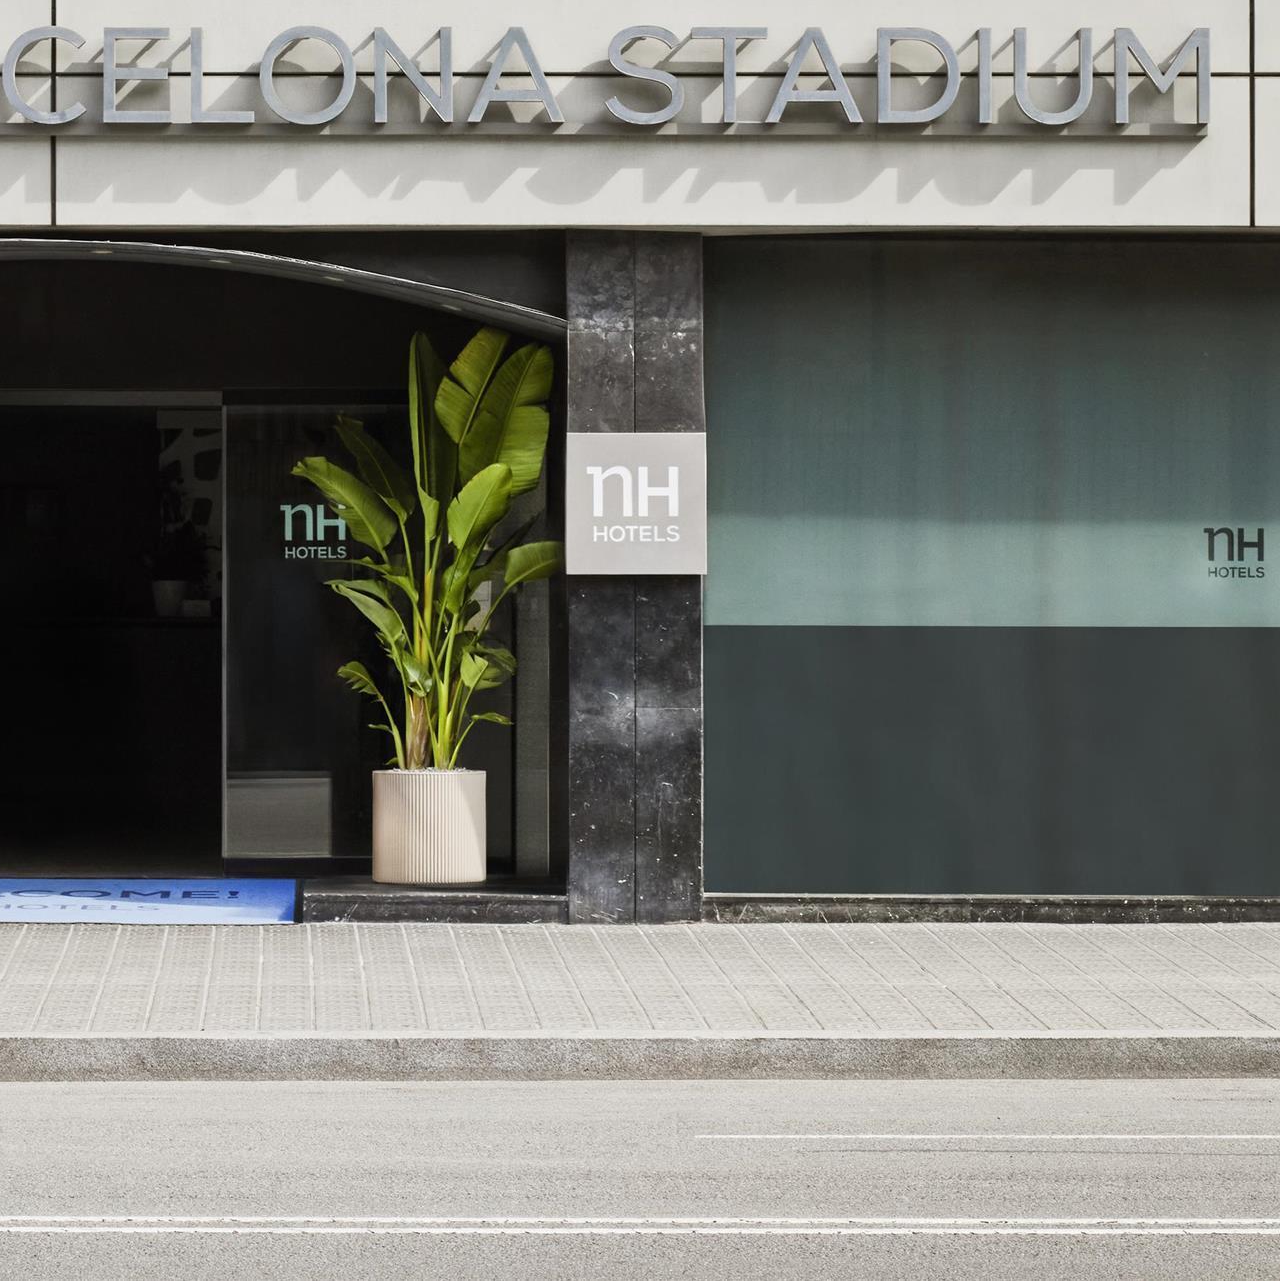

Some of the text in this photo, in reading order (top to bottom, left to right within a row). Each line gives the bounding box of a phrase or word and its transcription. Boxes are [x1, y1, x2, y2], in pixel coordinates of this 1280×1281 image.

[604, 25, 1212, 126] STADIUM
[593, 525, 680, 542] HOTELS
[285, 546, 347, 559] HOTELS
[1208, 566, 1265, 578] HOTELS
